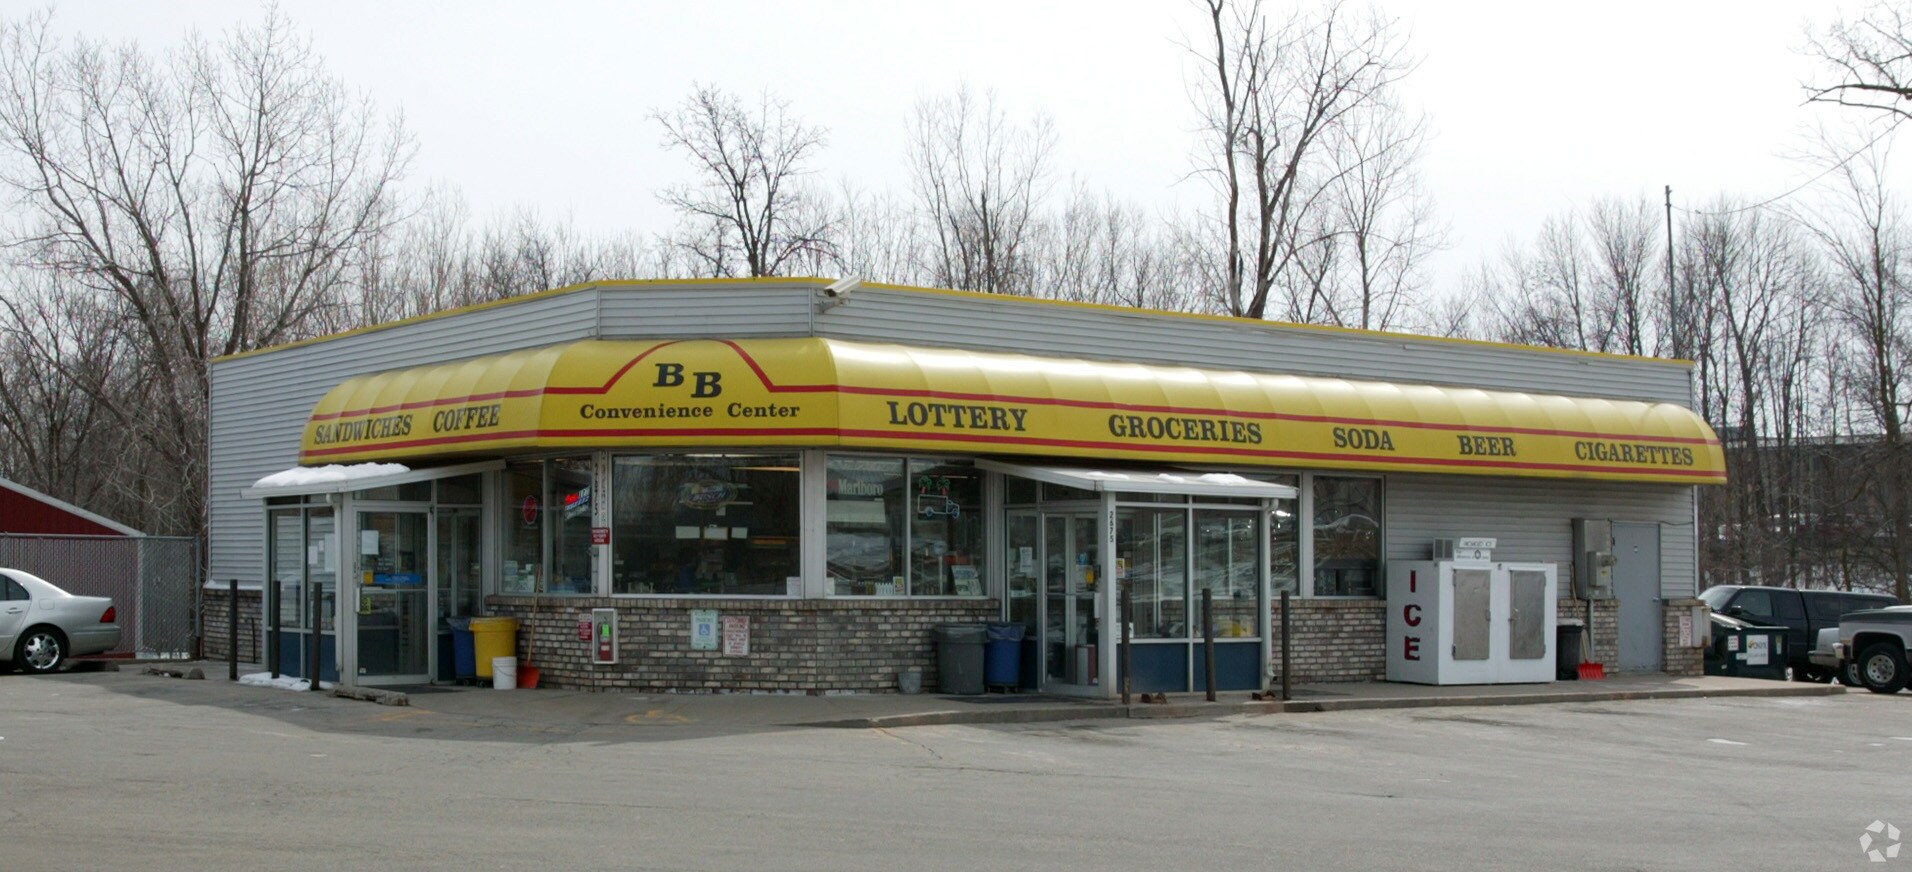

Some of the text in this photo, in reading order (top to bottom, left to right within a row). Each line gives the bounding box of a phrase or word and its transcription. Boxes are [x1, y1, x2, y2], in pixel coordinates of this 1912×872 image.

[313, 403, 502, 446] SANDWICHES COFFEE
[580, 402, 801, 419] Convenience Center
[887, 400, 1695, 466] LOTTERY GROCERIES SODA BEER CIGARETTES
[838, 478, 884, 497] Marlboro
[1403, 569, 1422, 661] ICE
